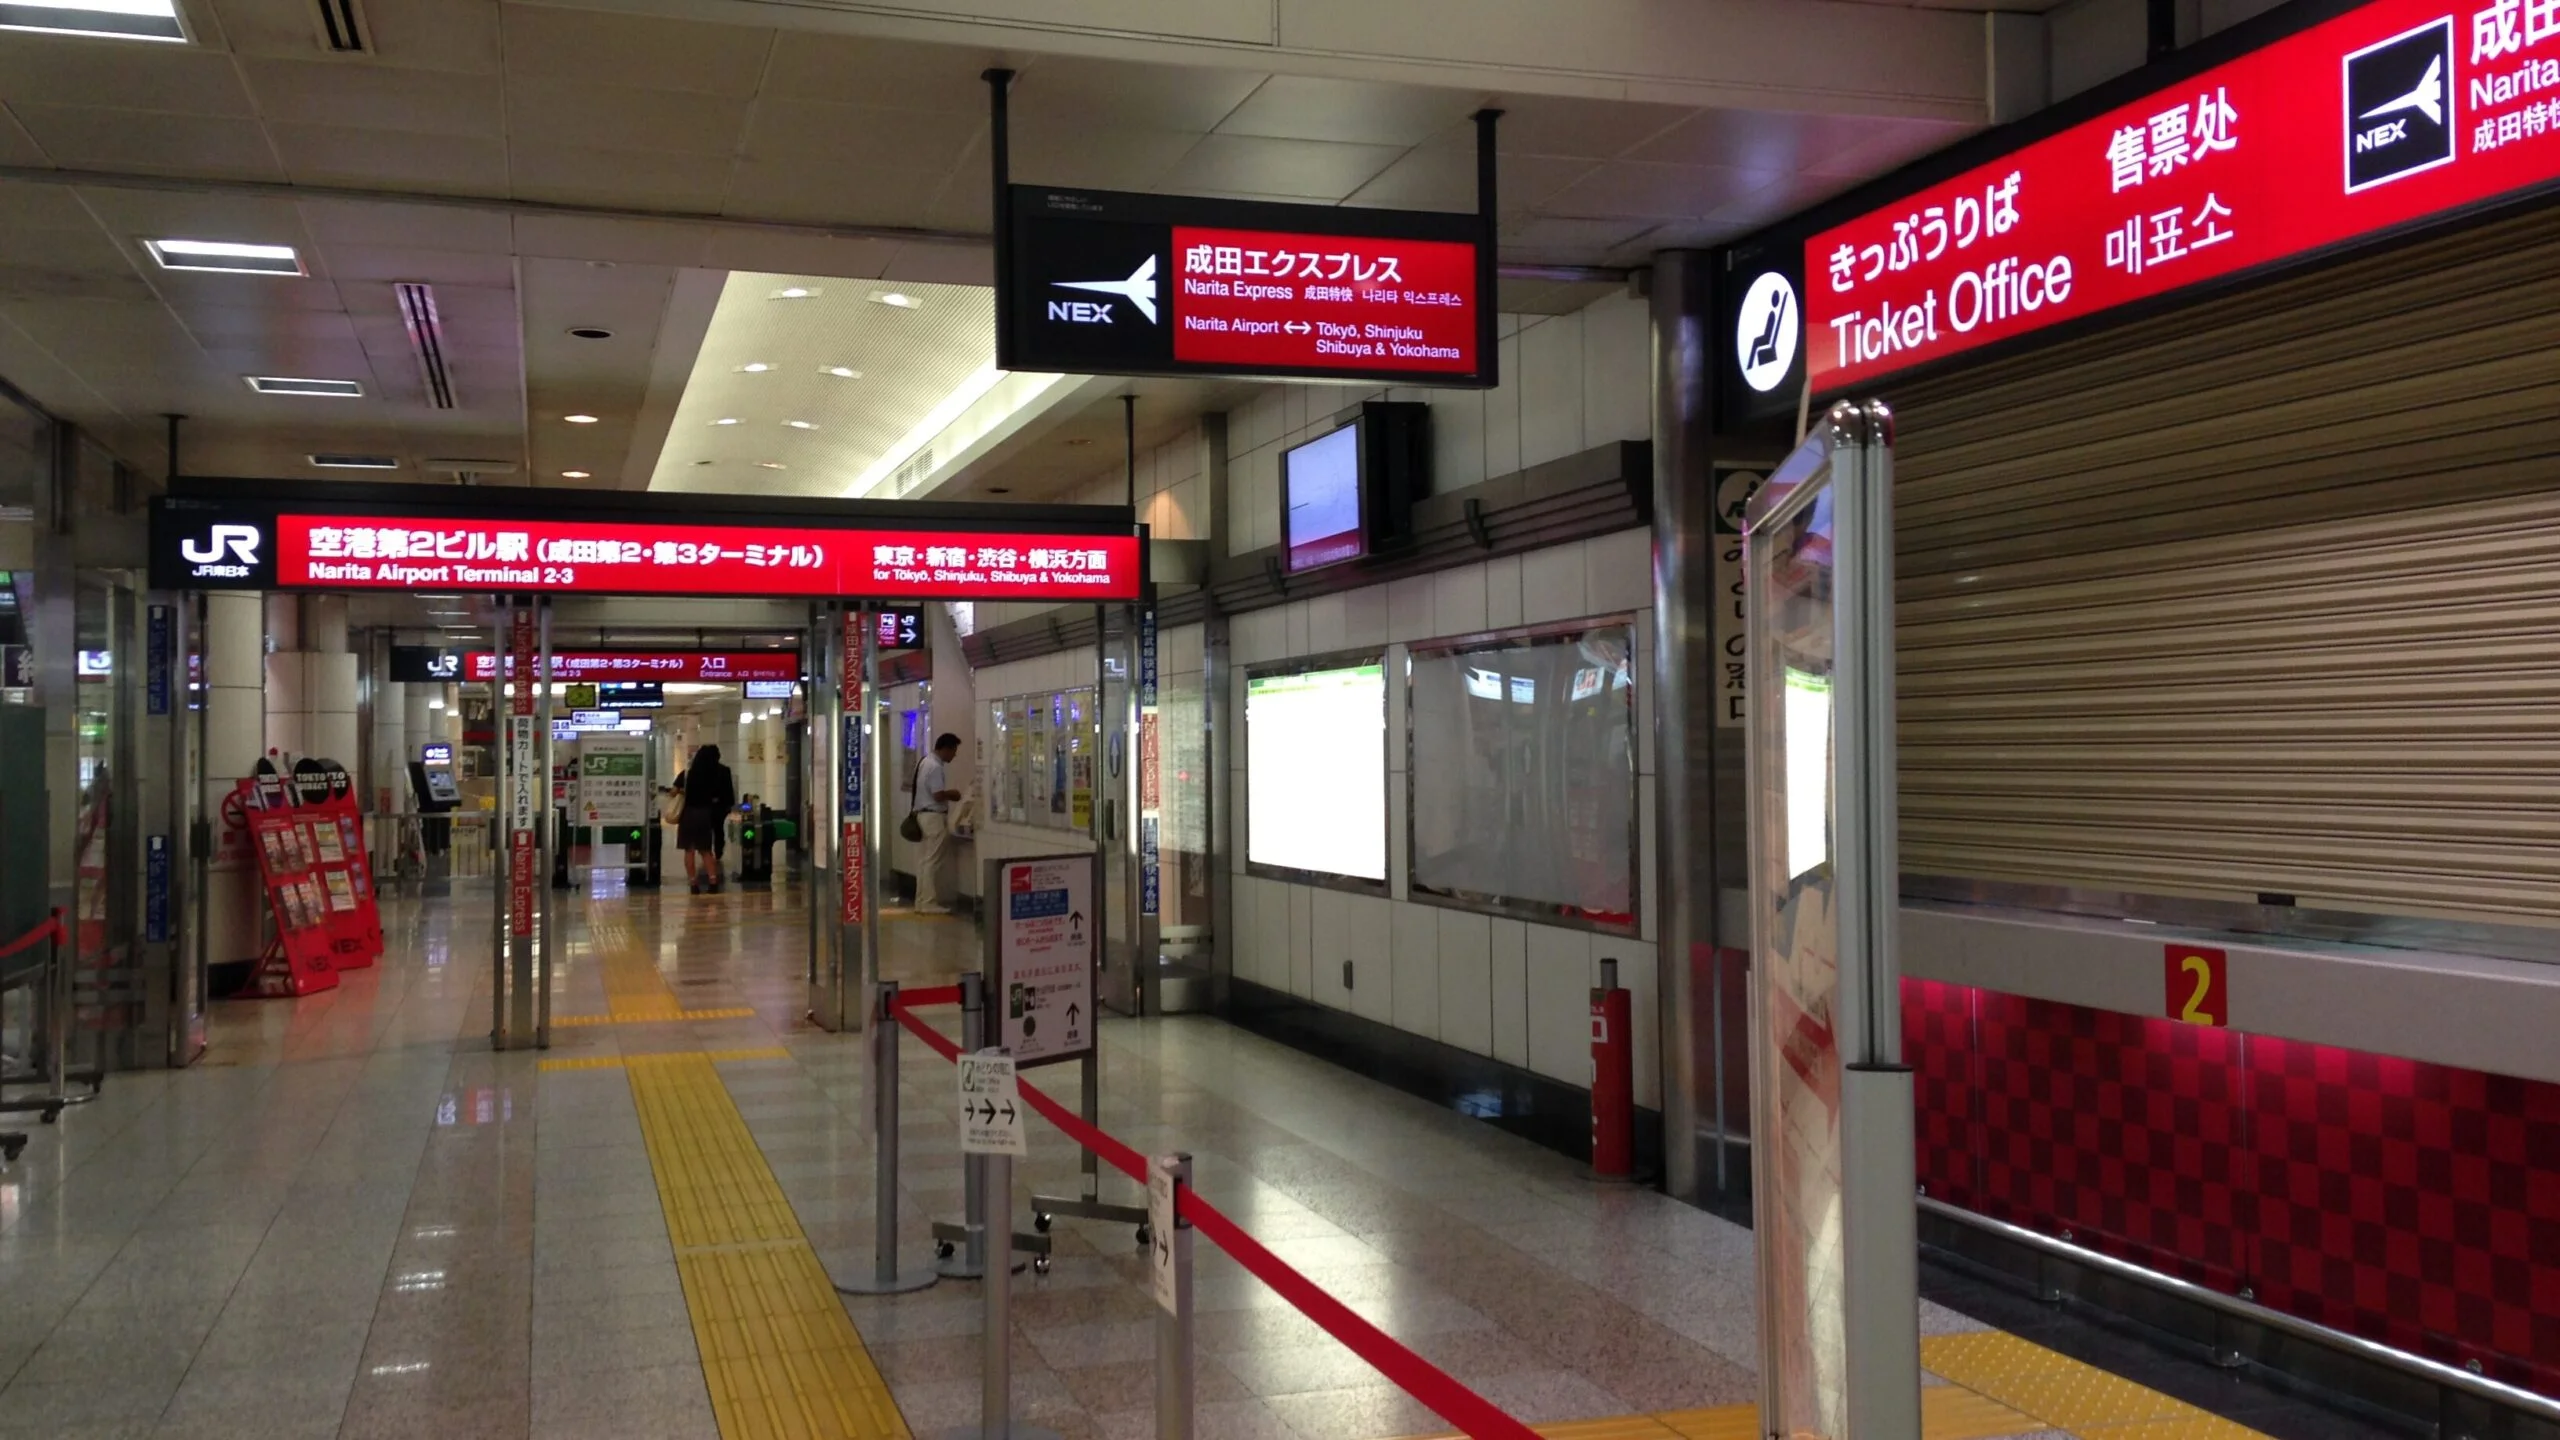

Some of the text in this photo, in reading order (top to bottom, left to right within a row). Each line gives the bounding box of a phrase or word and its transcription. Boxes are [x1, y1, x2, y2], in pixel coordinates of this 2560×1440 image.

[2470, 58, 2560, 111] Narita
[2106, 86, 2239, 194] 售票处
[1829, 171, 2022, 293] きっぷうりば
[2106, 193, 2235, 276] 매표소
[1184, 244, 1403, 284] 成田エクスプレス
[1184, 279, 1293, 303] Narita Express
[1304, 285, 1353, 302] 成田特快
[1362, 288, 1463, 307] 나리타 익스프레스
[1829, 253, 2071, 369] Ticket Office
[1185, 315, 1228, 332] Narita
[1232, 317, 1279, 337] Airport
[1364, 322, 1423, 342] Shinjuku
[1316, 339, 1460, 359] Shibuya & Yokohama
[182, 524, 259, 564] JR
[308, 527, 528, 561] 空港第2ビル駅
[873, 544, 1107, 571] 東京・新宿・渋谷・横浜方面
[192, 565, 249, 578] JR東日本
[308, 562, 371, 579] Narita
[377, 563, 449, 583] Airport
[453, 565, 538, 583] Terminal
[873, 568, 890, 582] for
[934, 568, 987, 585] Shinjuku,
[990, 570, 1037, 586] Shibuya
[1039, 571, 1049, 583] &
[1052, 571, 1110, 585] Yokohama
[427, 655, 458, 672] JR
[700, 656, 725, 669] 入口
[700, 670, 733, 678] Entrance
[846, 624, 859, 710] 成田エクスプレス
[586, 757, 608, 769] JR
[2181, 955, 2213, 1026] 2
